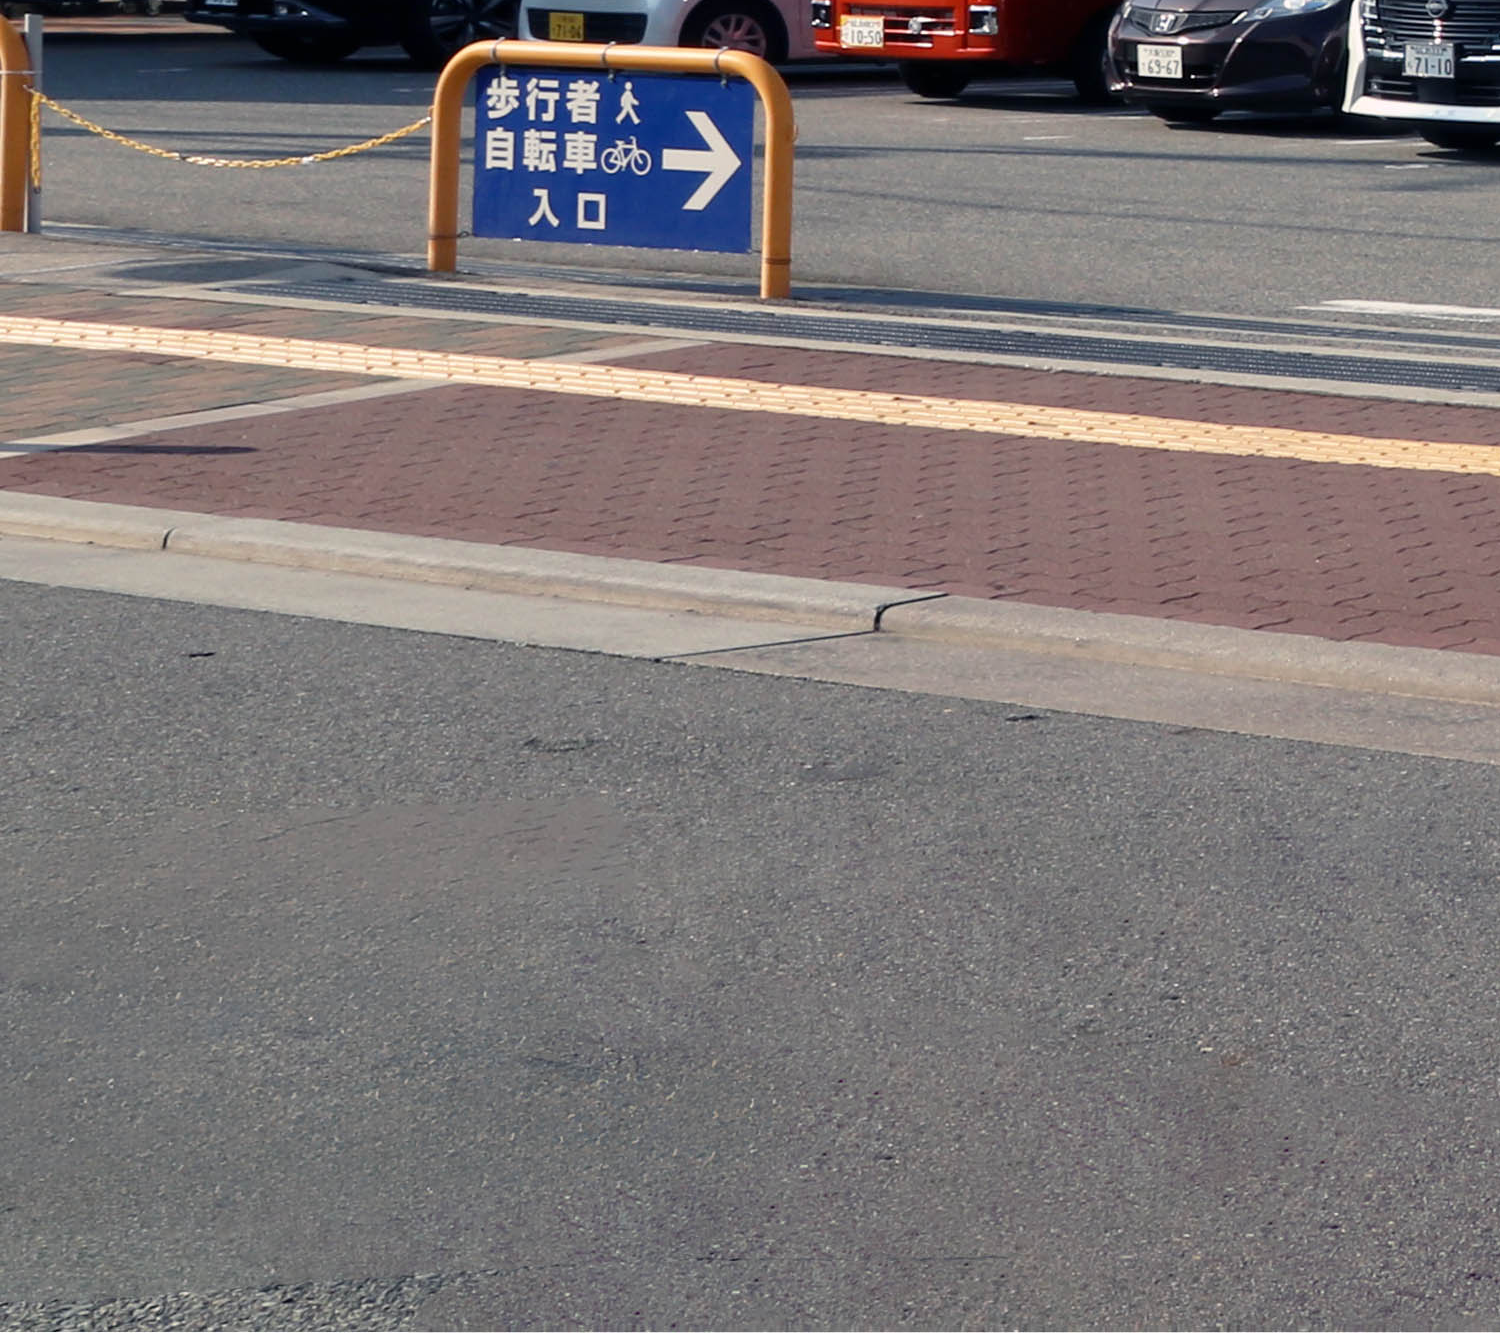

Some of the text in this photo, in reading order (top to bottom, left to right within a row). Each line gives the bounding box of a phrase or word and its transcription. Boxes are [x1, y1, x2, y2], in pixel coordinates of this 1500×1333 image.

[850, 29, 882, 45] 10-50
[1147, 59, 1180, 75] 69-67
[1415, 56, 1453, 75] 71-10
[486, 76, 600, 124] 歩行者
[485, 126, 598, 174] 自転車
[528, 188, 606, 230] 入口
